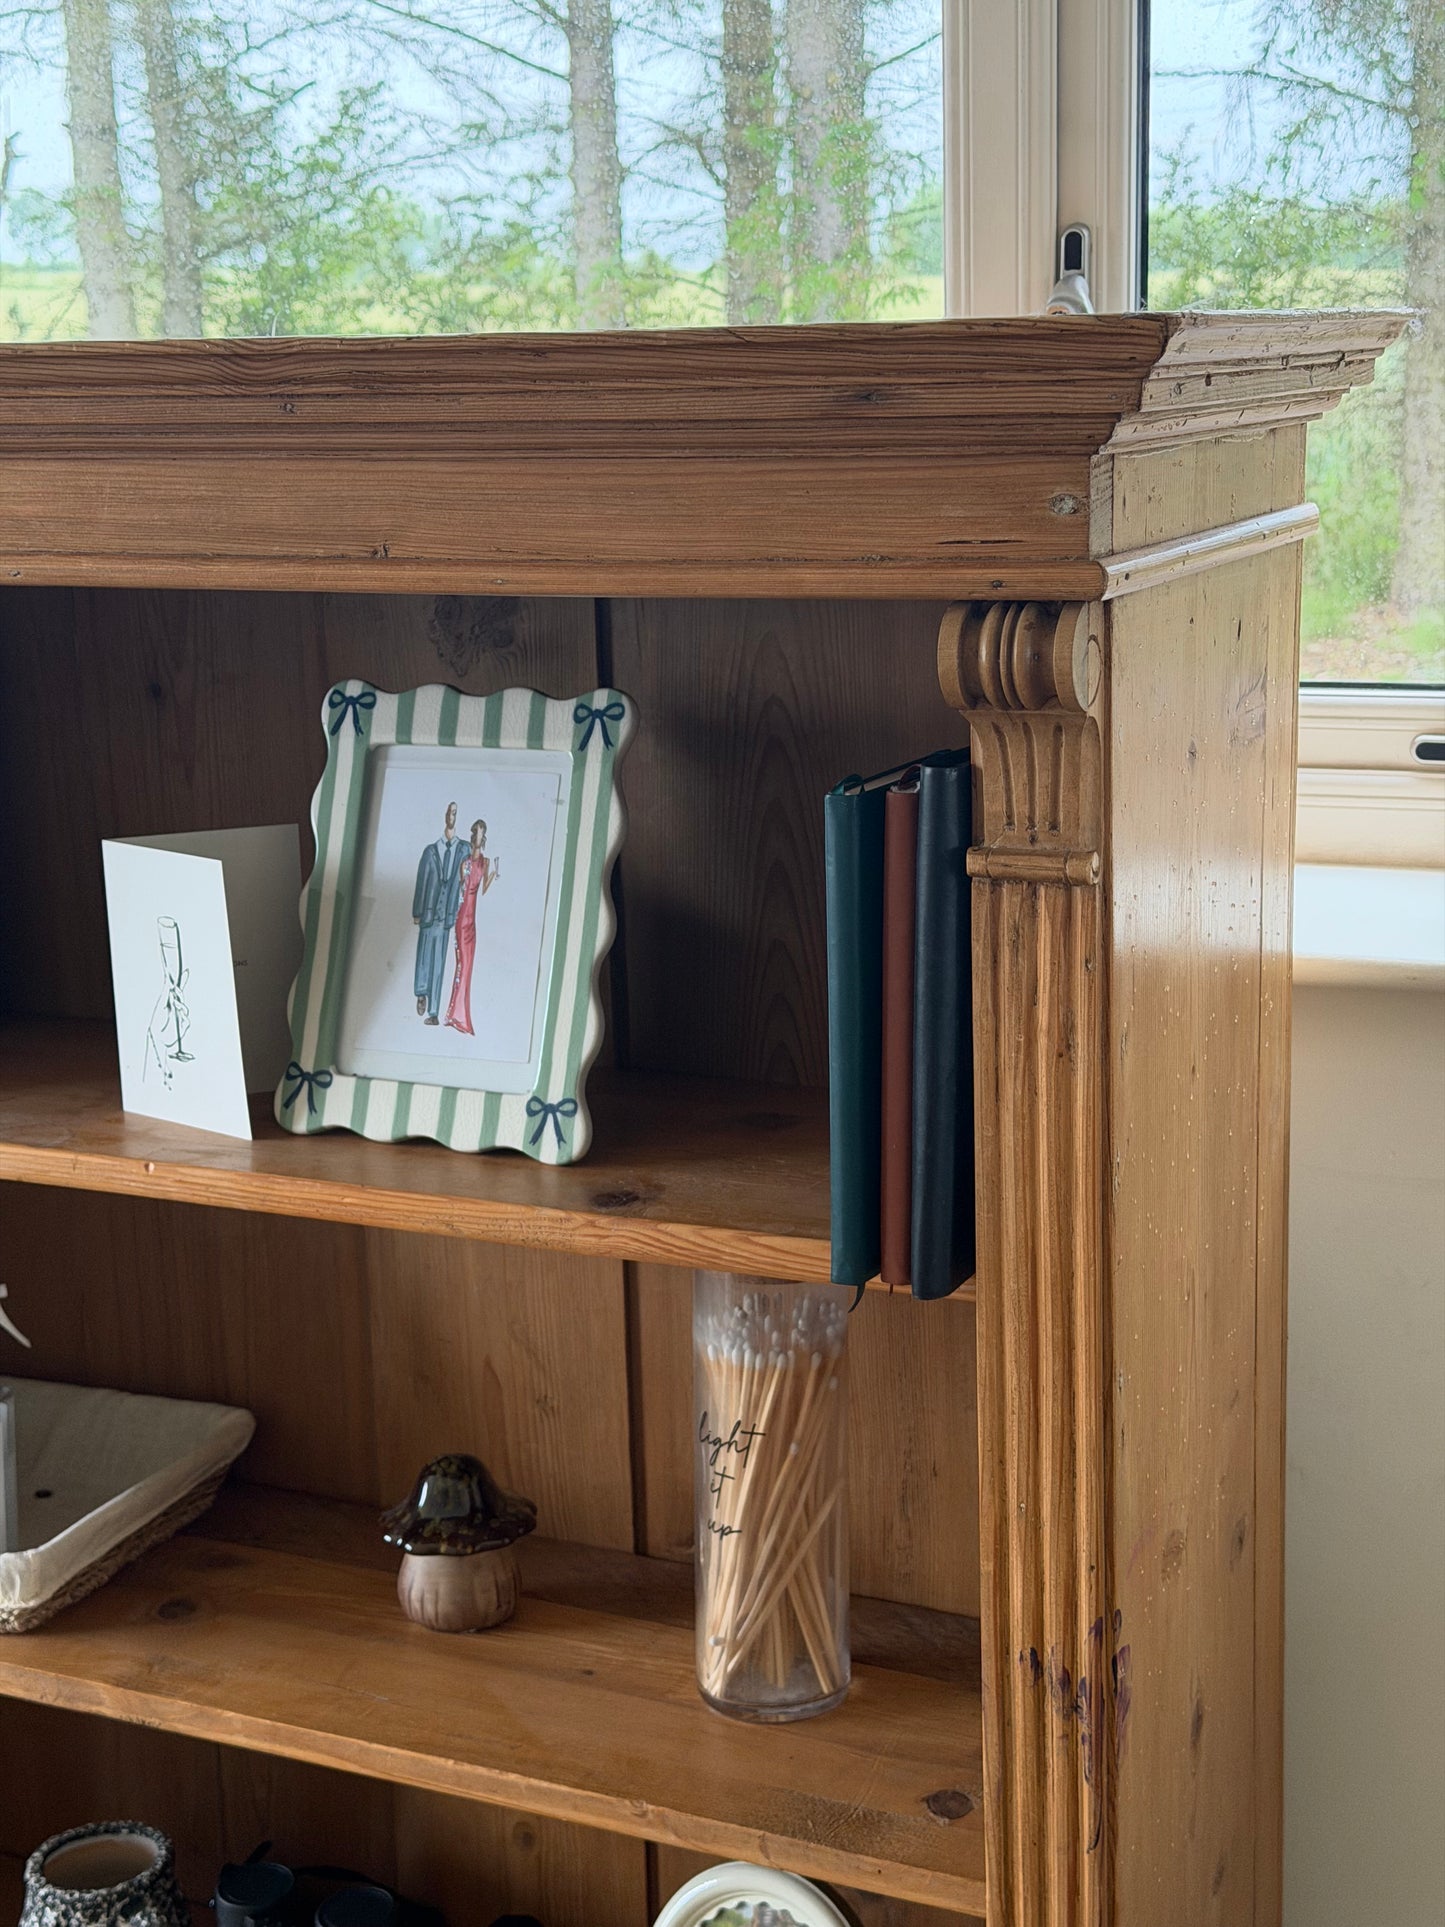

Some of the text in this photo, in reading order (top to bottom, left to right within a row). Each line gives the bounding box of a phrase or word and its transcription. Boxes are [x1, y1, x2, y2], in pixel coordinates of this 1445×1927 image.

[699, 1411, 766, 1468] light
[710, 1466, 735, 1509] it
[707, 1519, 742, 1541] up
